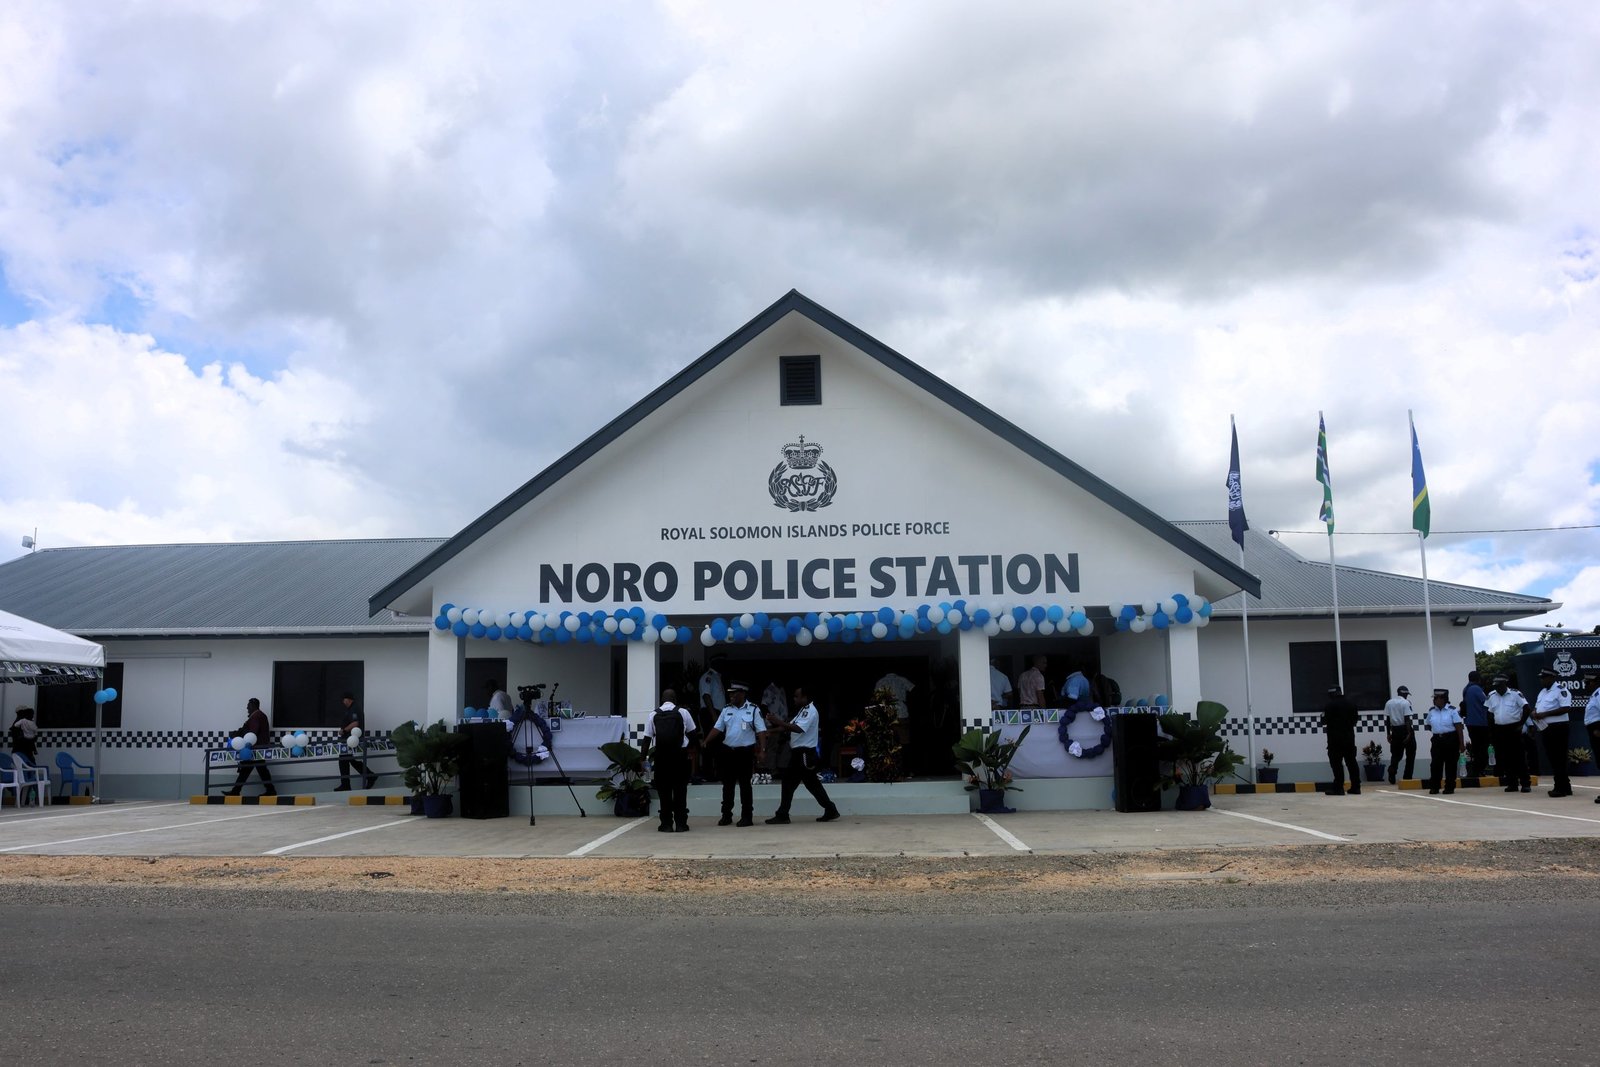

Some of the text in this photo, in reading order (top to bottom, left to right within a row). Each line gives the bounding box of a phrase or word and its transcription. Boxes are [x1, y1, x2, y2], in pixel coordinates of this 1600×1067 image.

[661, 522, 950, 541] ROYAL SOLOMON ISLANDS POLICE FORCE
[539, 553, 1080, 604] NORO POLICE STATION
[1558, 680, 1580, 690] ORO
